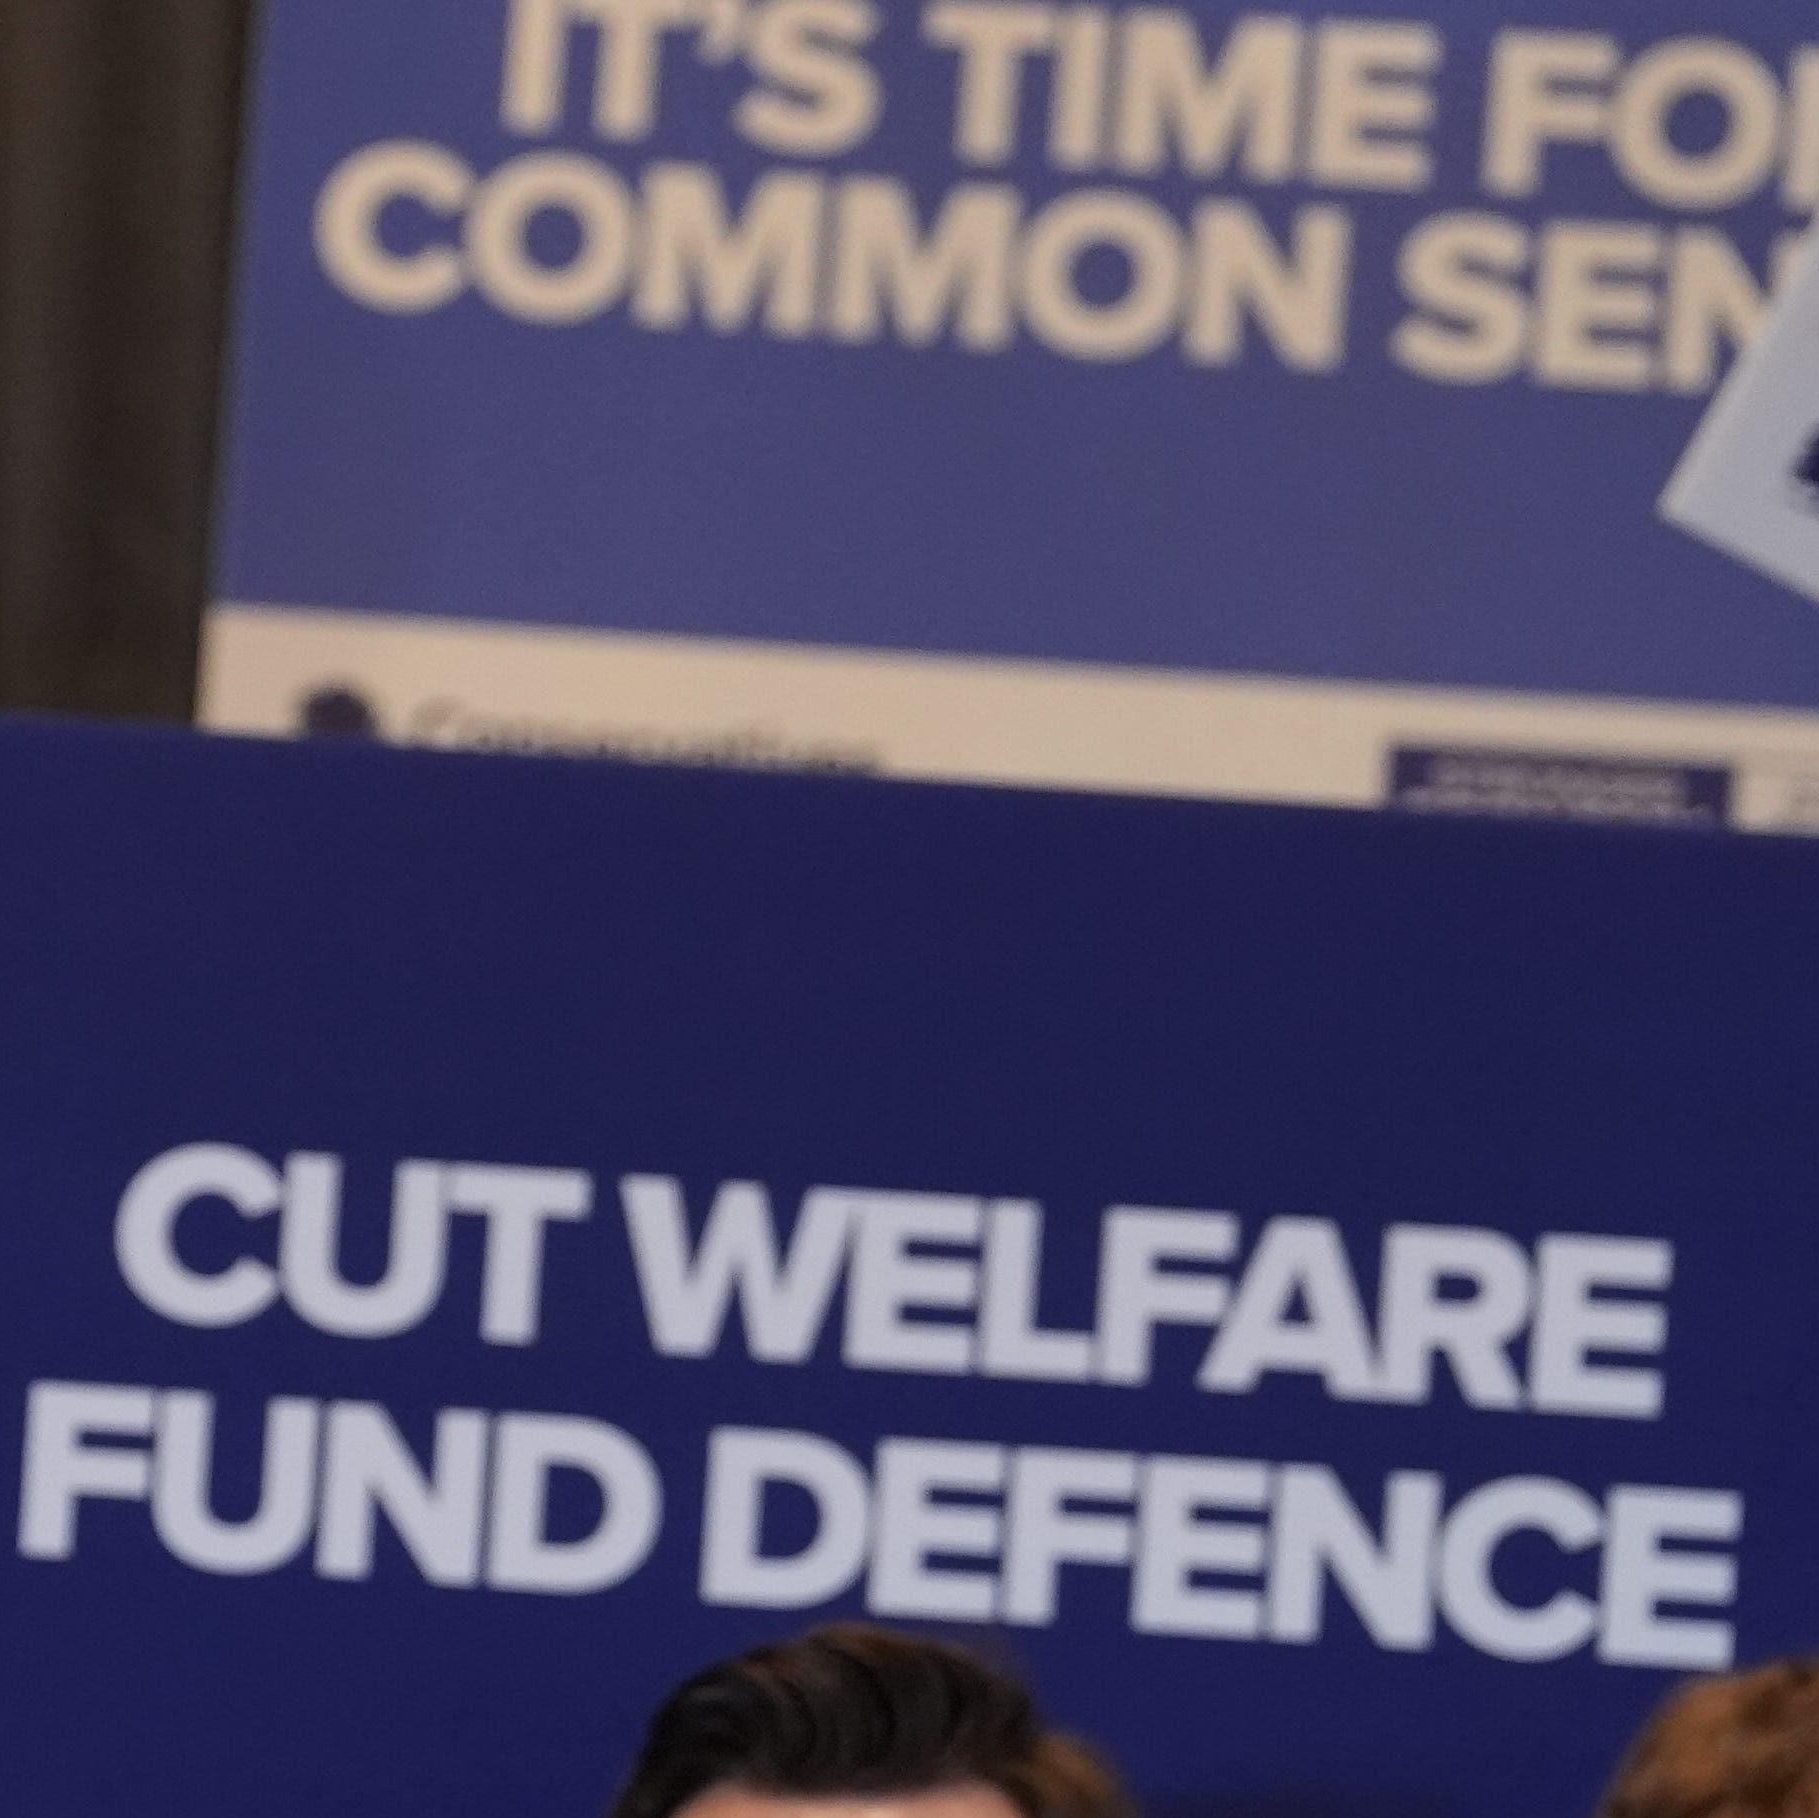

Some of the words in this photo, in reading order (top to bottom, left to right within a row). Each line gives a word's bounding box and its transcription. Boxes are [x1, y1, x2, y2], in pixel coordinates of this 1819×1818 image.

[501, 0, 883, 158] IT'S
[925, 8, 1445, 187] TIME
[1479, 28, 1819, 210] FO
[315, 140, 1355, 374] COMMON
[113, 1141, 593, 1346] CUT
[619, 1174, 1675, 1418] WELFARE
[16, 1380, 663, 1595] FUND
[698, 1426, 1745, 1672] DEFENCE
